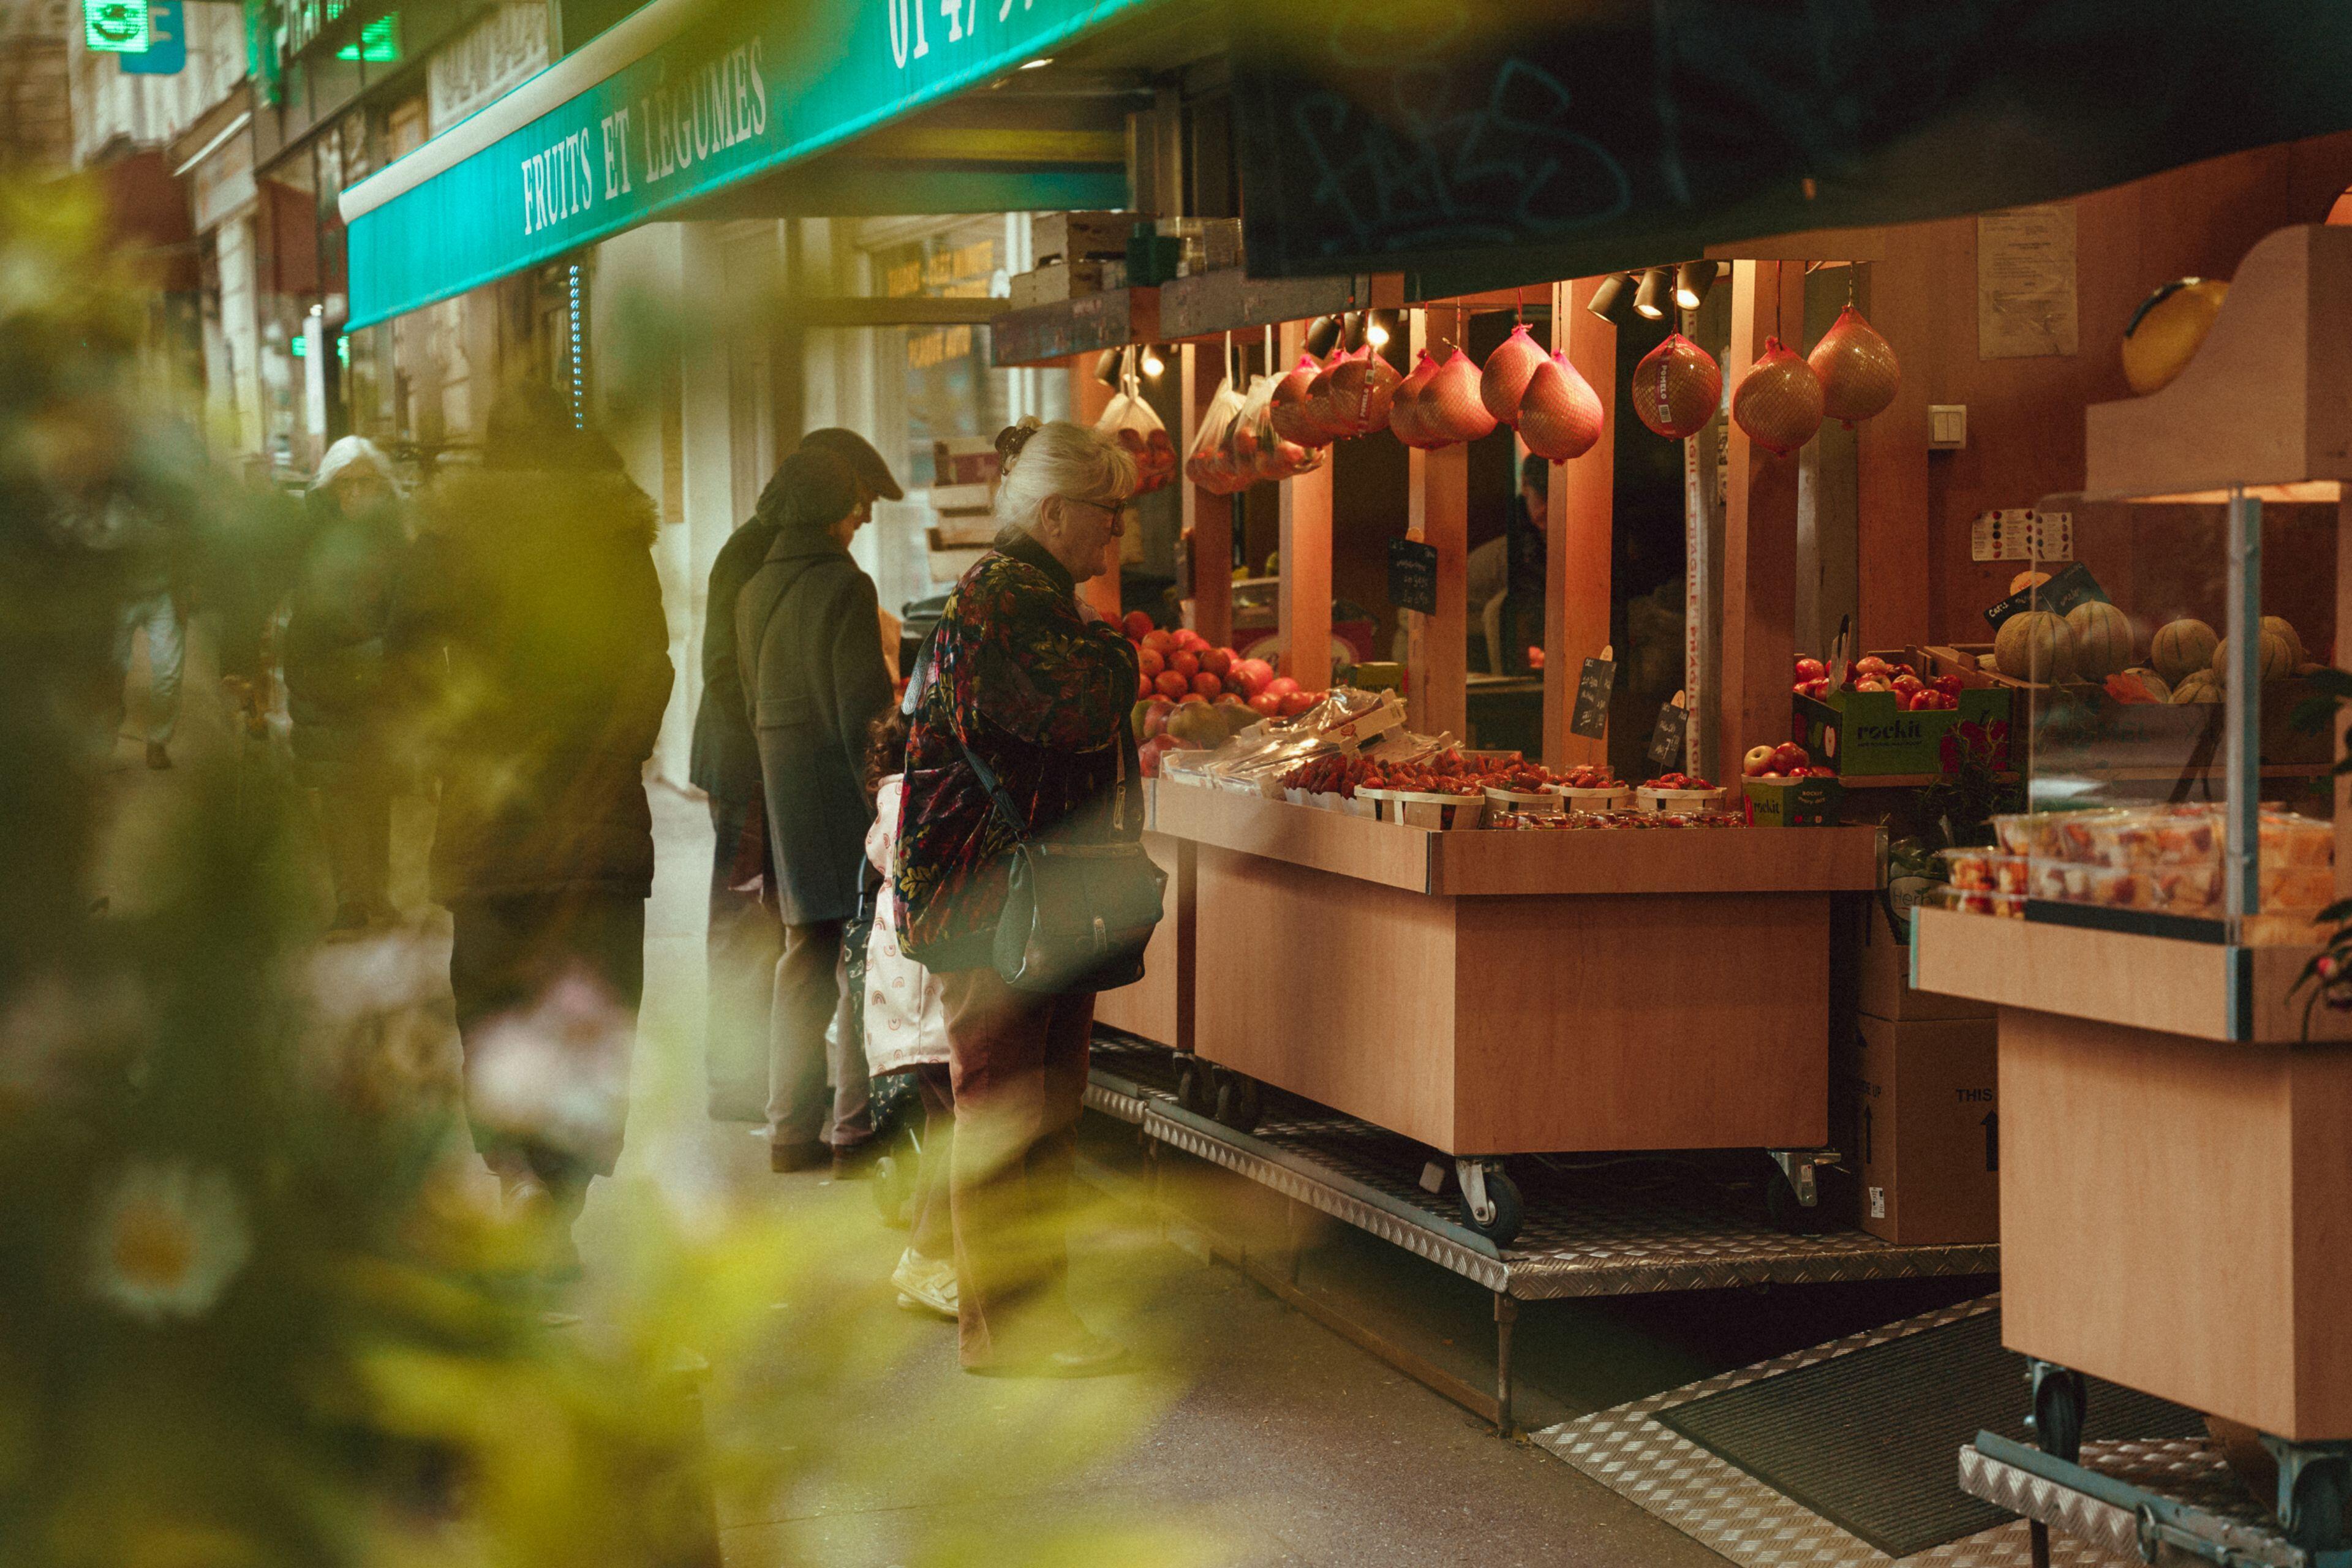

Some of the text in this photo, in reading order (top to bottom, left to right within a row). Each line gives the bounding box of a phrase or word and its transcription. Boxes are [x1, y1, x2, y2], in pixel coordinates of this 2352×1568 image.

[521, 126, 592, 235] FRUITS
[601, 107, 631, 200] ET
[641, 36, 767, 183] LÉGUMES
[1857, 719, 1921, 739] rockit
[1956, 1088, 1992, 1103] THIS
